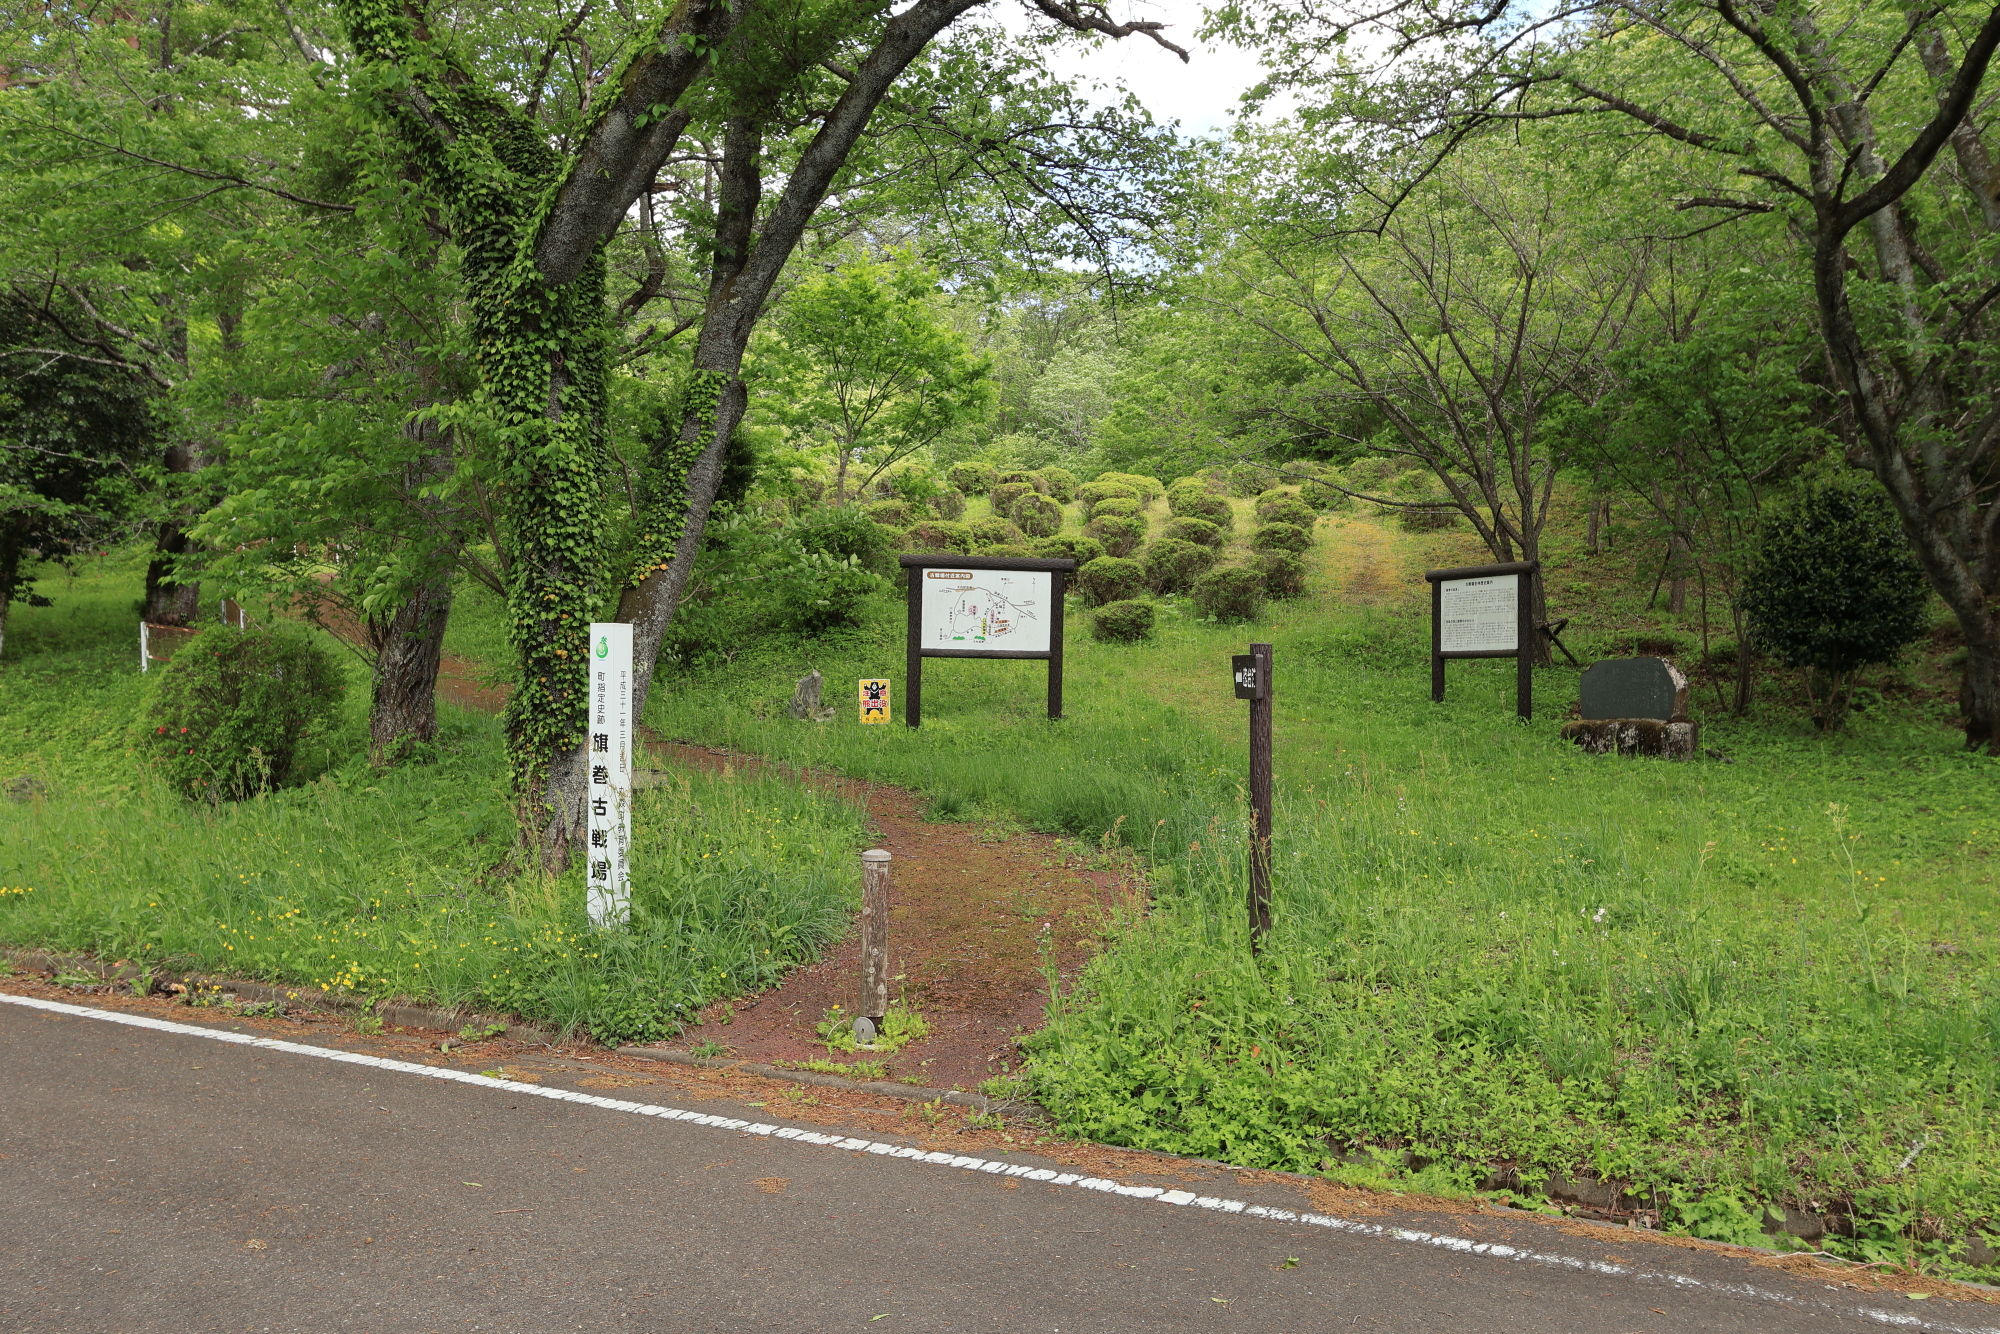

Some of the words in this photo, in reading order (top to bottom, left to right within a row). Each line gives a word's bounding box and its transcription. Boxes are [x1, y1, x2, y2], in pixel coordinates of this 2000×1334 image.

[597, 671, 606, 725] 町指定史跡
[591, 733, 608, 881] 旗巻古戦場
